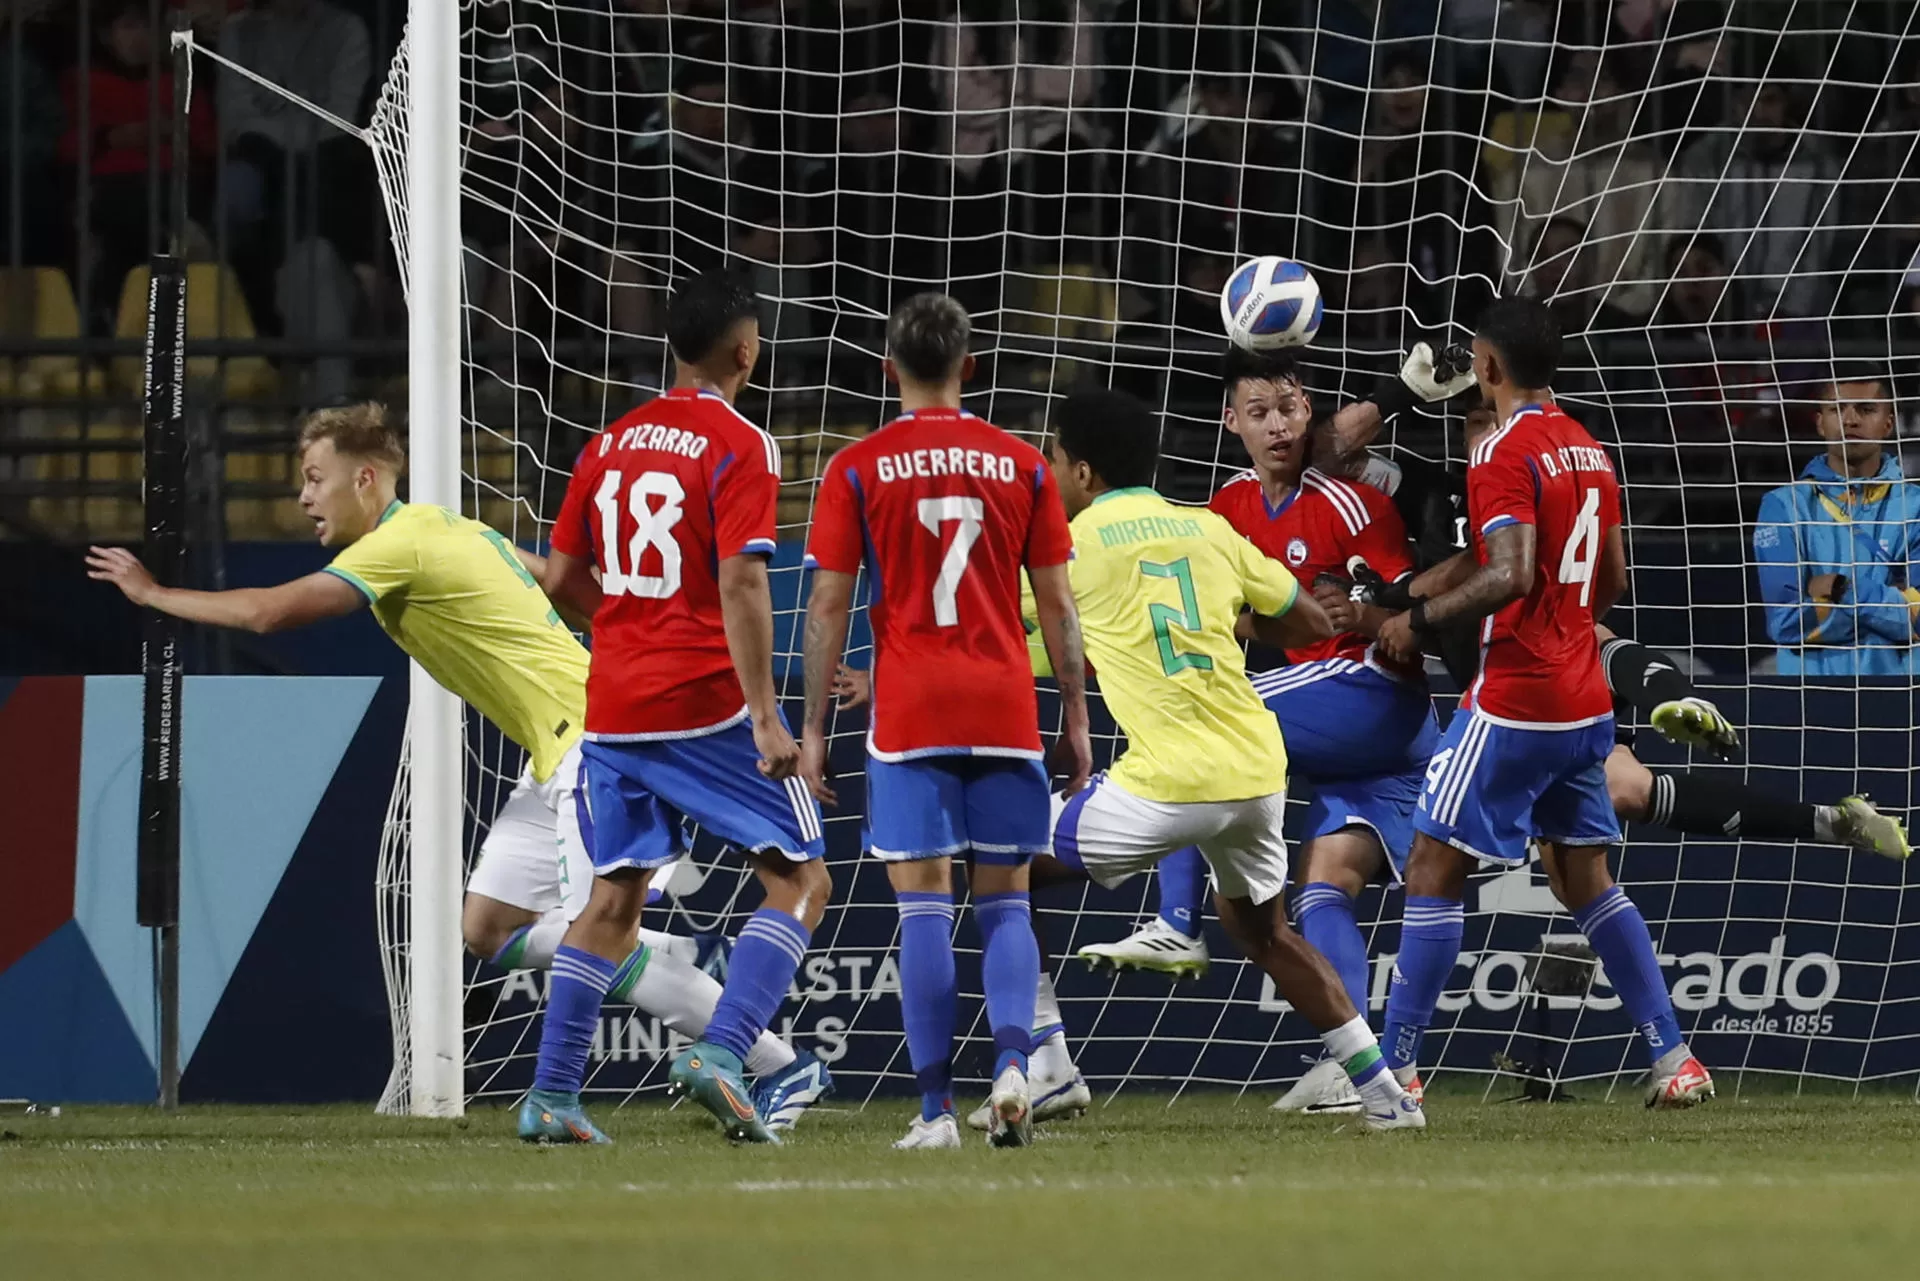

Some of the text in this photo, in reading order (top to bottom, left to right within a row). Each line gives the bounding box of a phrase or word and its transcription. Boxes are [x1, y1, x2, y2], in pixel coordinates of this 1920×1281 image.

[1239, 291, 1265, 329] molten
[618, 424, 709, 459] PIZARRO
[876, 447, 1015, 483] GUERRERO
[1541, 452, 1562, 477] D.
[594, 470, 686, 599] 18
[1097, 515, 1205, 549] MIRANDA
[1558, 488, 1600, 607] 4
[917, 496, 984, 627] 7
[1139, 557, 1214, 677] 2
[158, 642, 174, 781] WWW.REDESARENA.CL
[1425, 747, 1454, 795] 4
[1711, 1014, 1834, 1034] desde 1855
